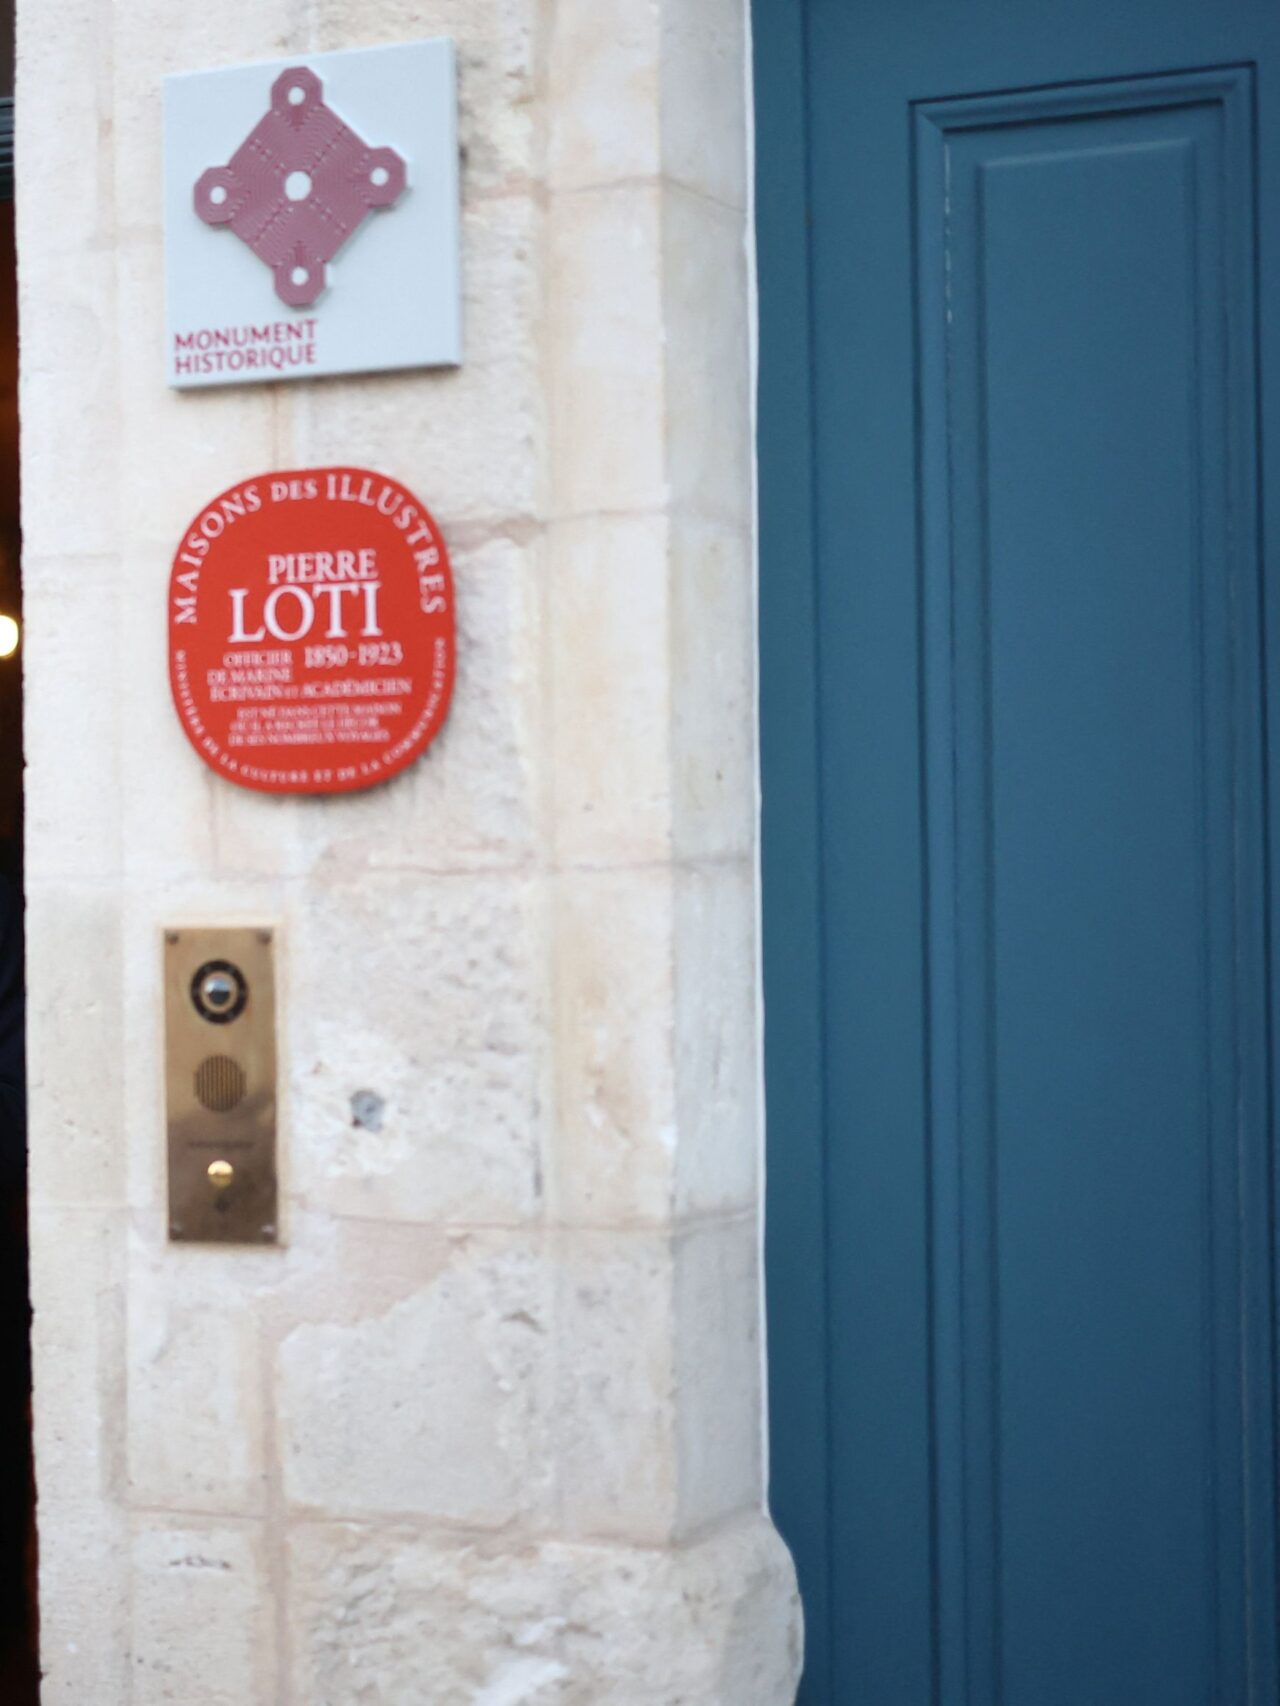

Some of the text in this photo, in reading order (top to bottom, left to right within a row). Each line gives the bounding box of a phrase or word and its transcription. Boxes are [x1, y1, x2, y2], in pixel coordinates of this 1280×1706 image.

[175, 319, 317, 349] MONUMENT
[175, 344, 316, 374] HISTORIQUE
[173, 474, 446, 624] MAISONS DES ILLUSTRES
[267, 549, 379, 584] PIERRE
[227, 580, 383, 643] LOTI
